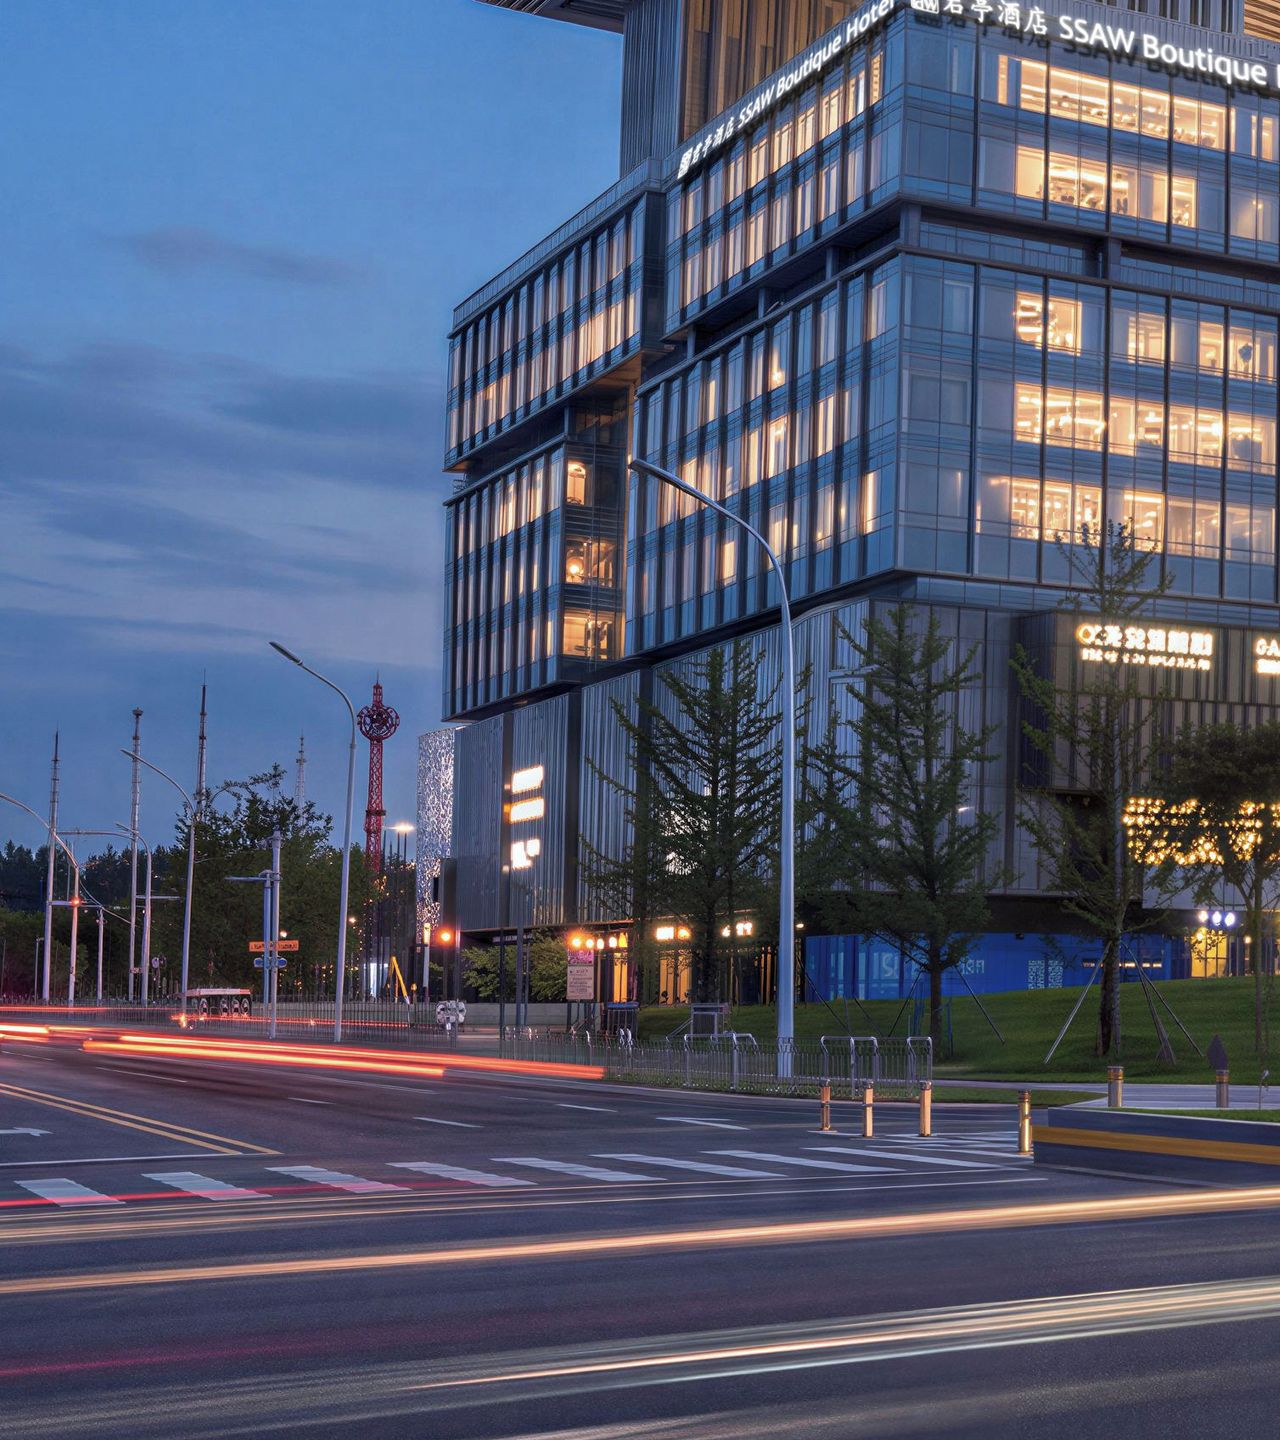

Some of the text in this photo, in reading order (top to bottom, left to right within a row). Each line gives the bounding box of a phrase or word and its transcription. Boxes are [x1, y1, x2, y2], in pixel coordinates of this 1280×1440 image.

[737, 84, 775, 129] SSAW
[775, 34, 842, 99] Boutique
[1059, 15, 1135, 53] SSAW
[1142, 33, 1268, 85] Boutique
